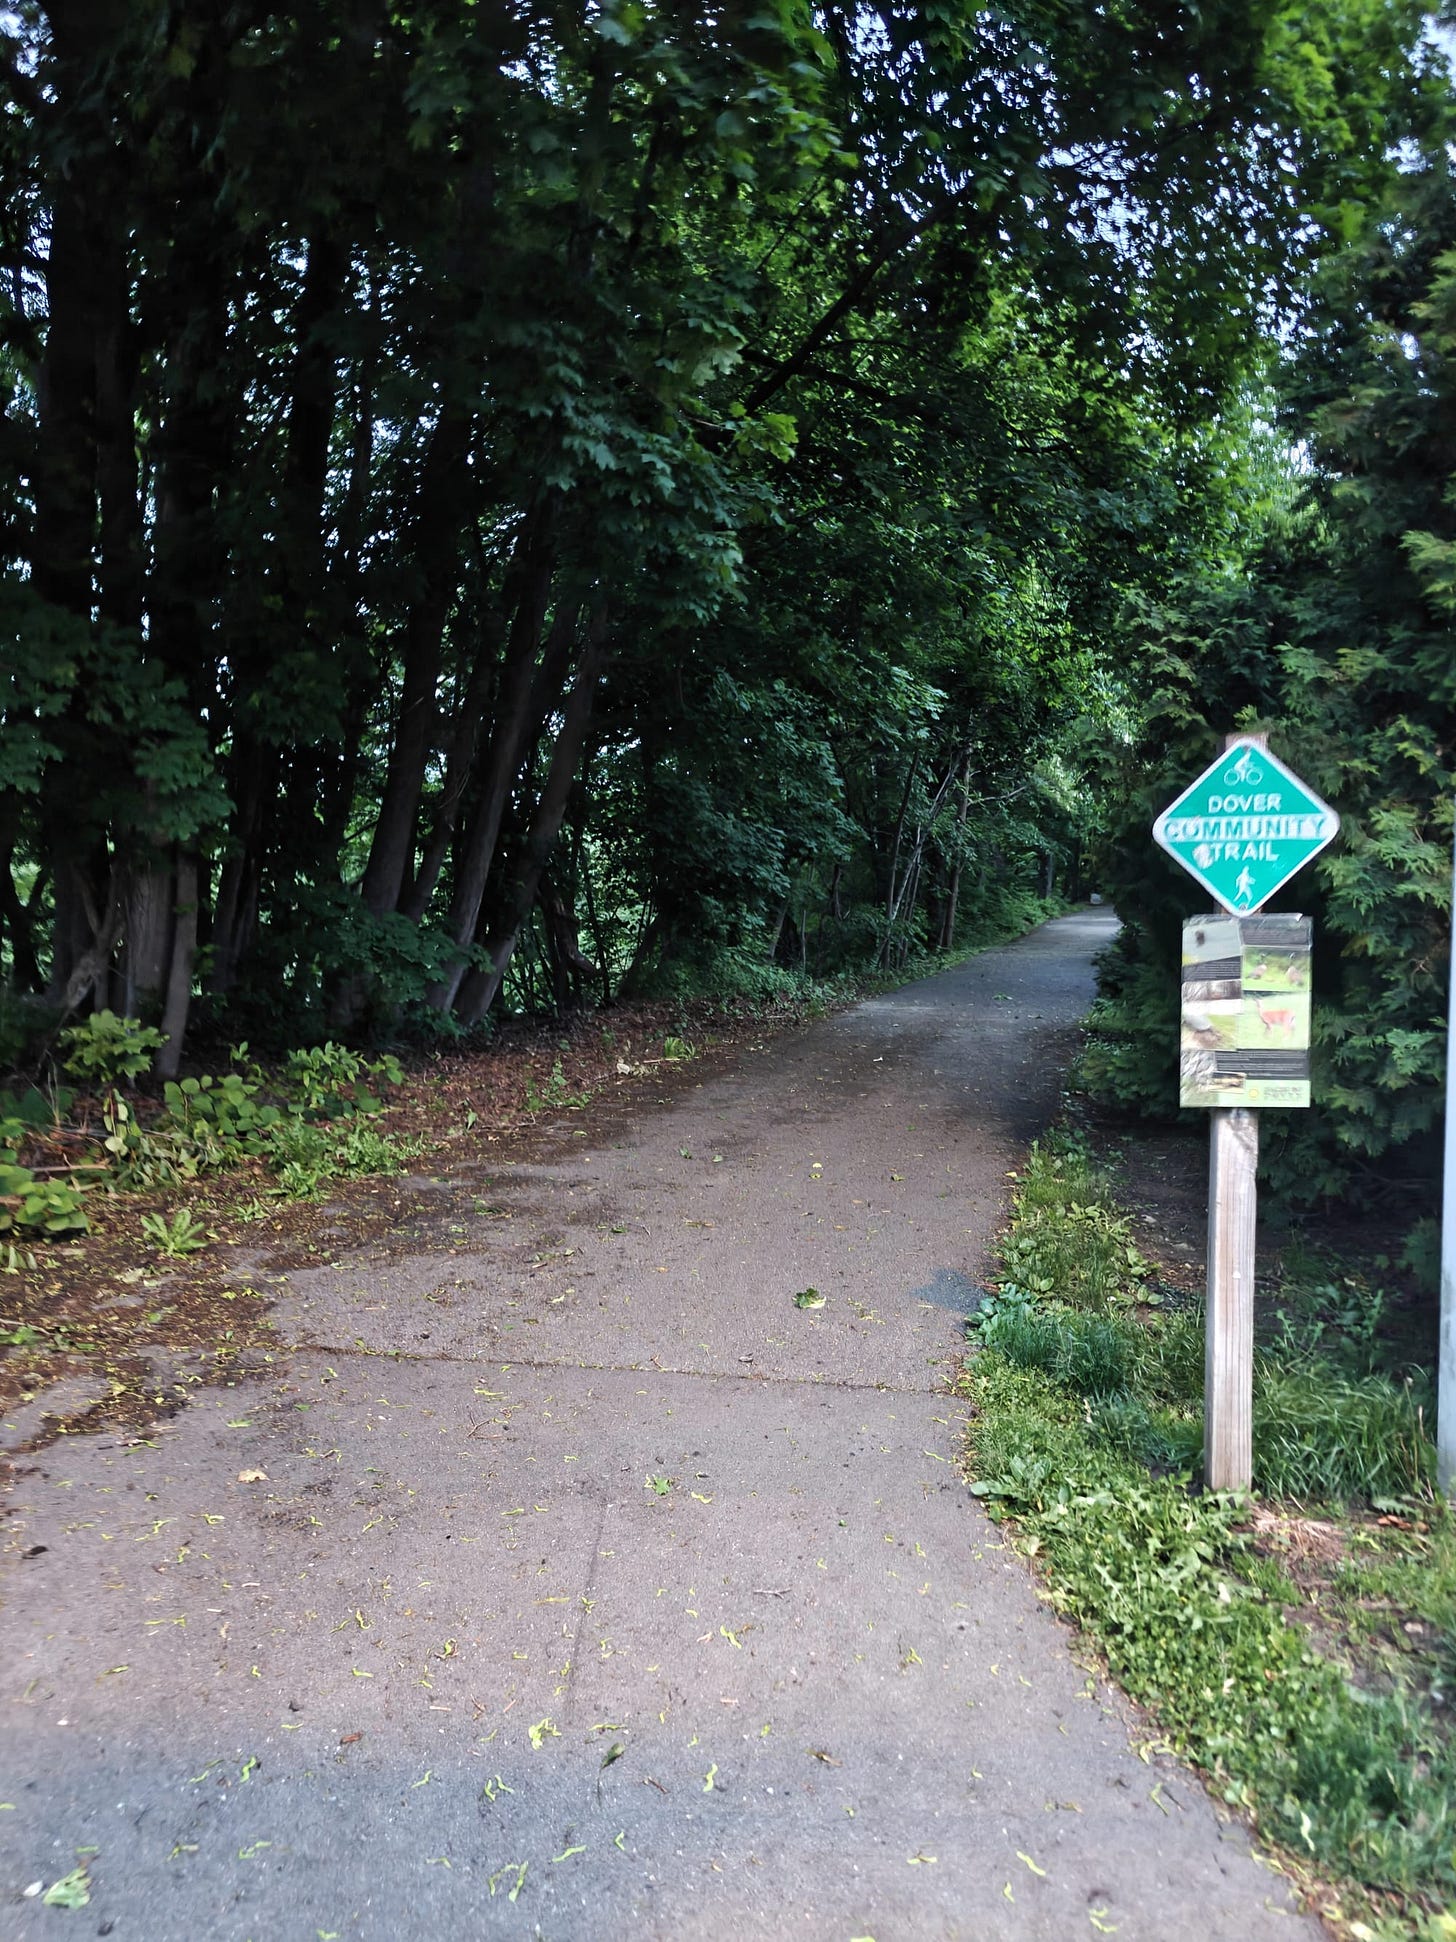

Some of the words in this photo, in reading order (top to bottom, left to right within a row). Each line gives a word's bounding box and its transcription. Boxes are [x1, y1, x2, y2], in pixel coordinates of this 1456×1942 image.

[1208, 793, 1281, 813] DOVER
[1164, 817, 1326, 841] COMMUNITY
[1211, 841, 1280, 862] TRAIL
